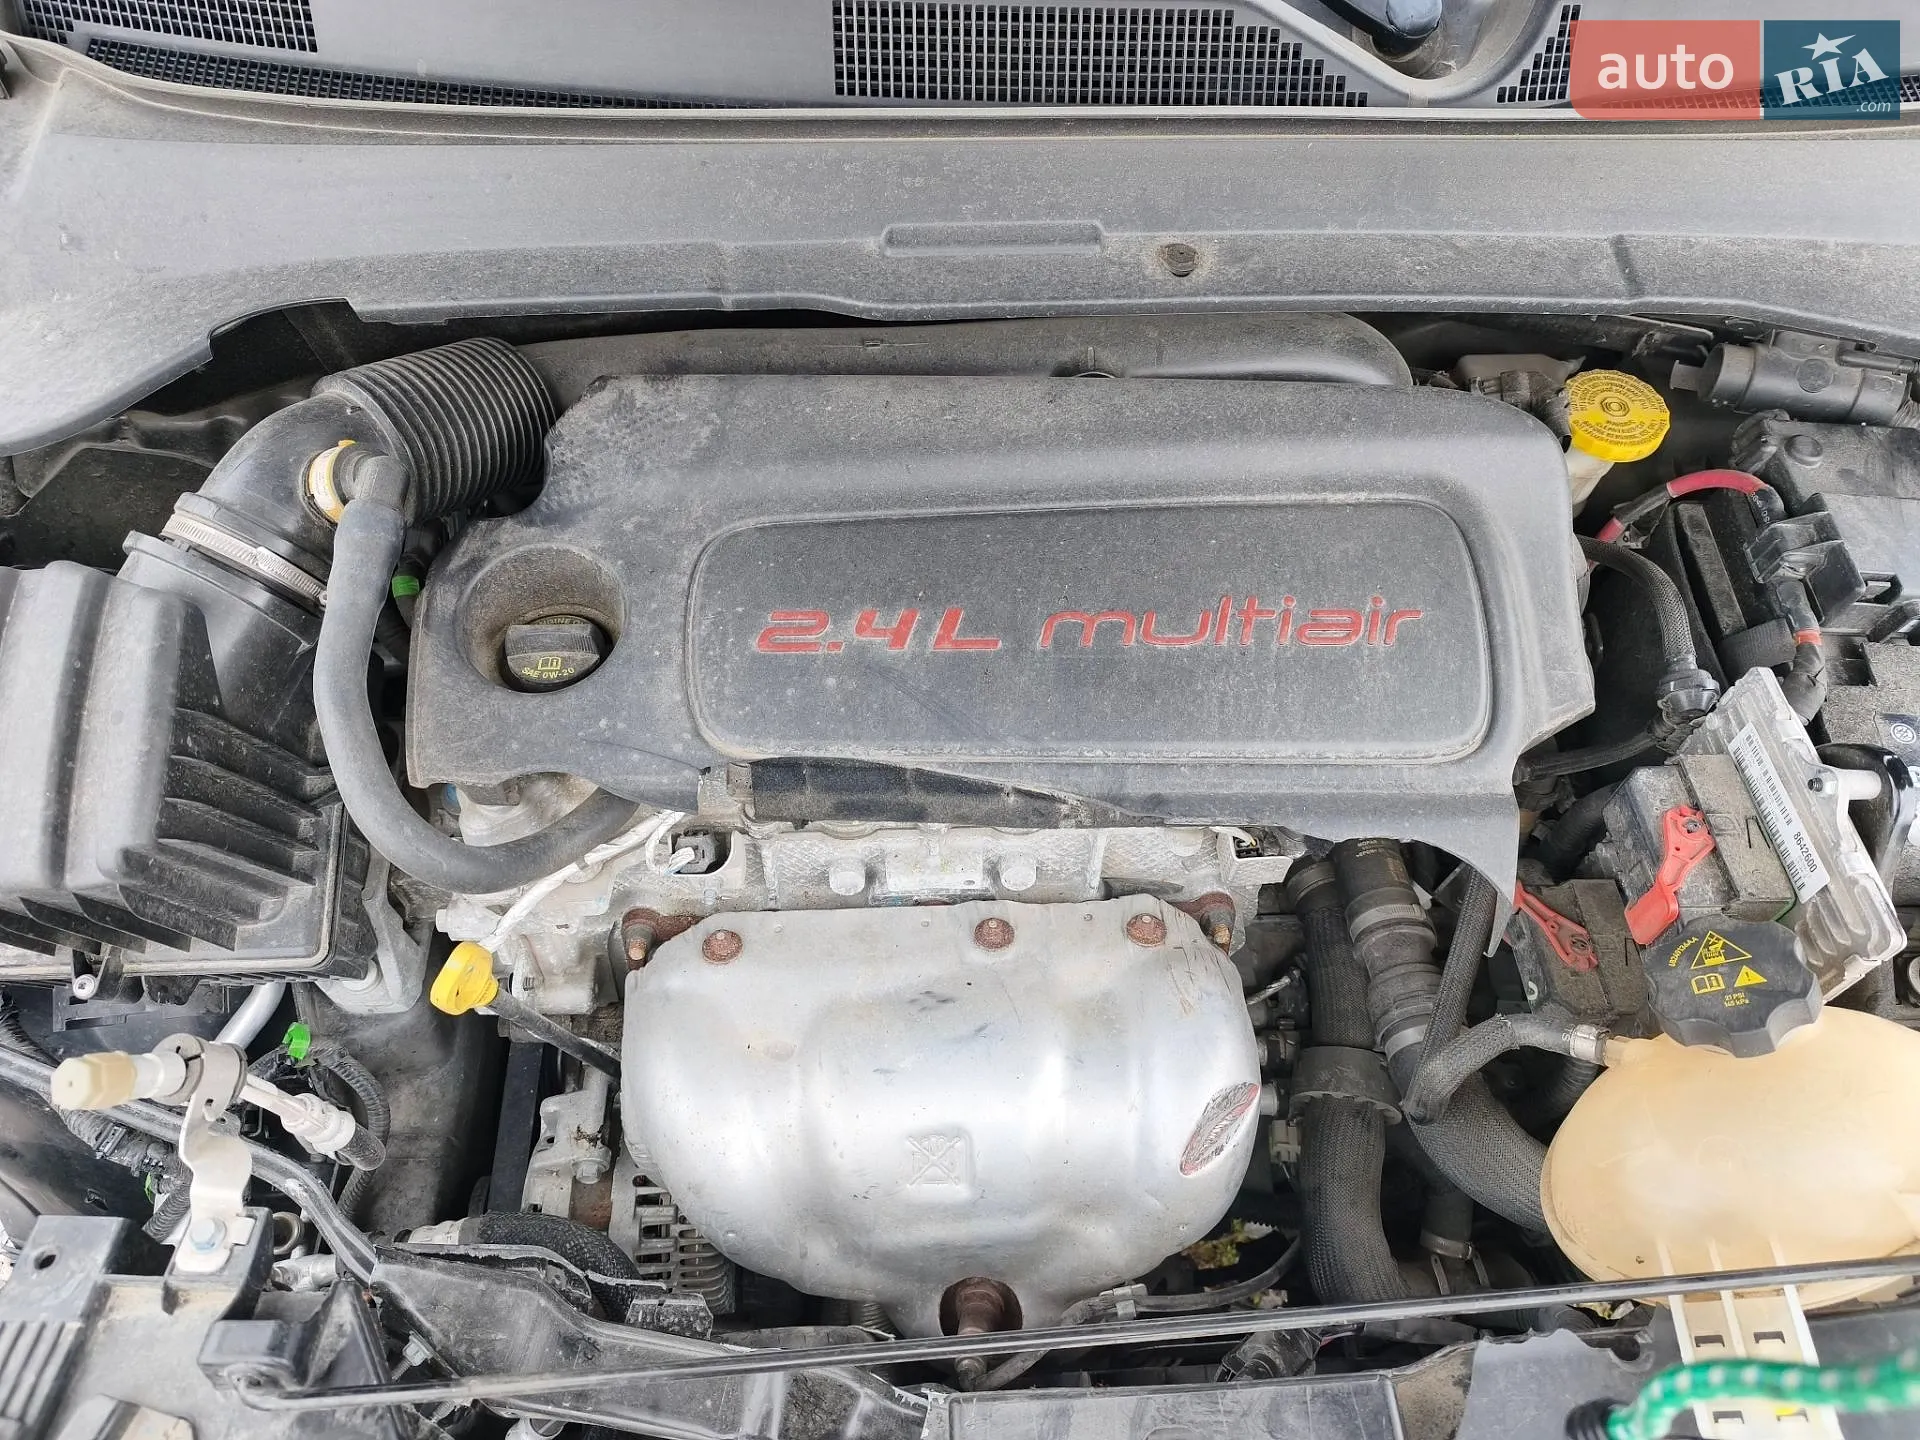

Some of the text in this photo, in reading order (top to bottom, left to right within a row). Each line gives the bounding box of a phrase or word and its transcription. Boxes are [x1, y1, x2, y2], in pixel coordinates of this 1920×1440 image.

[1040, 595, 1422, 647] multiair
[521, 666, 575, 679] SAE 0W-20
